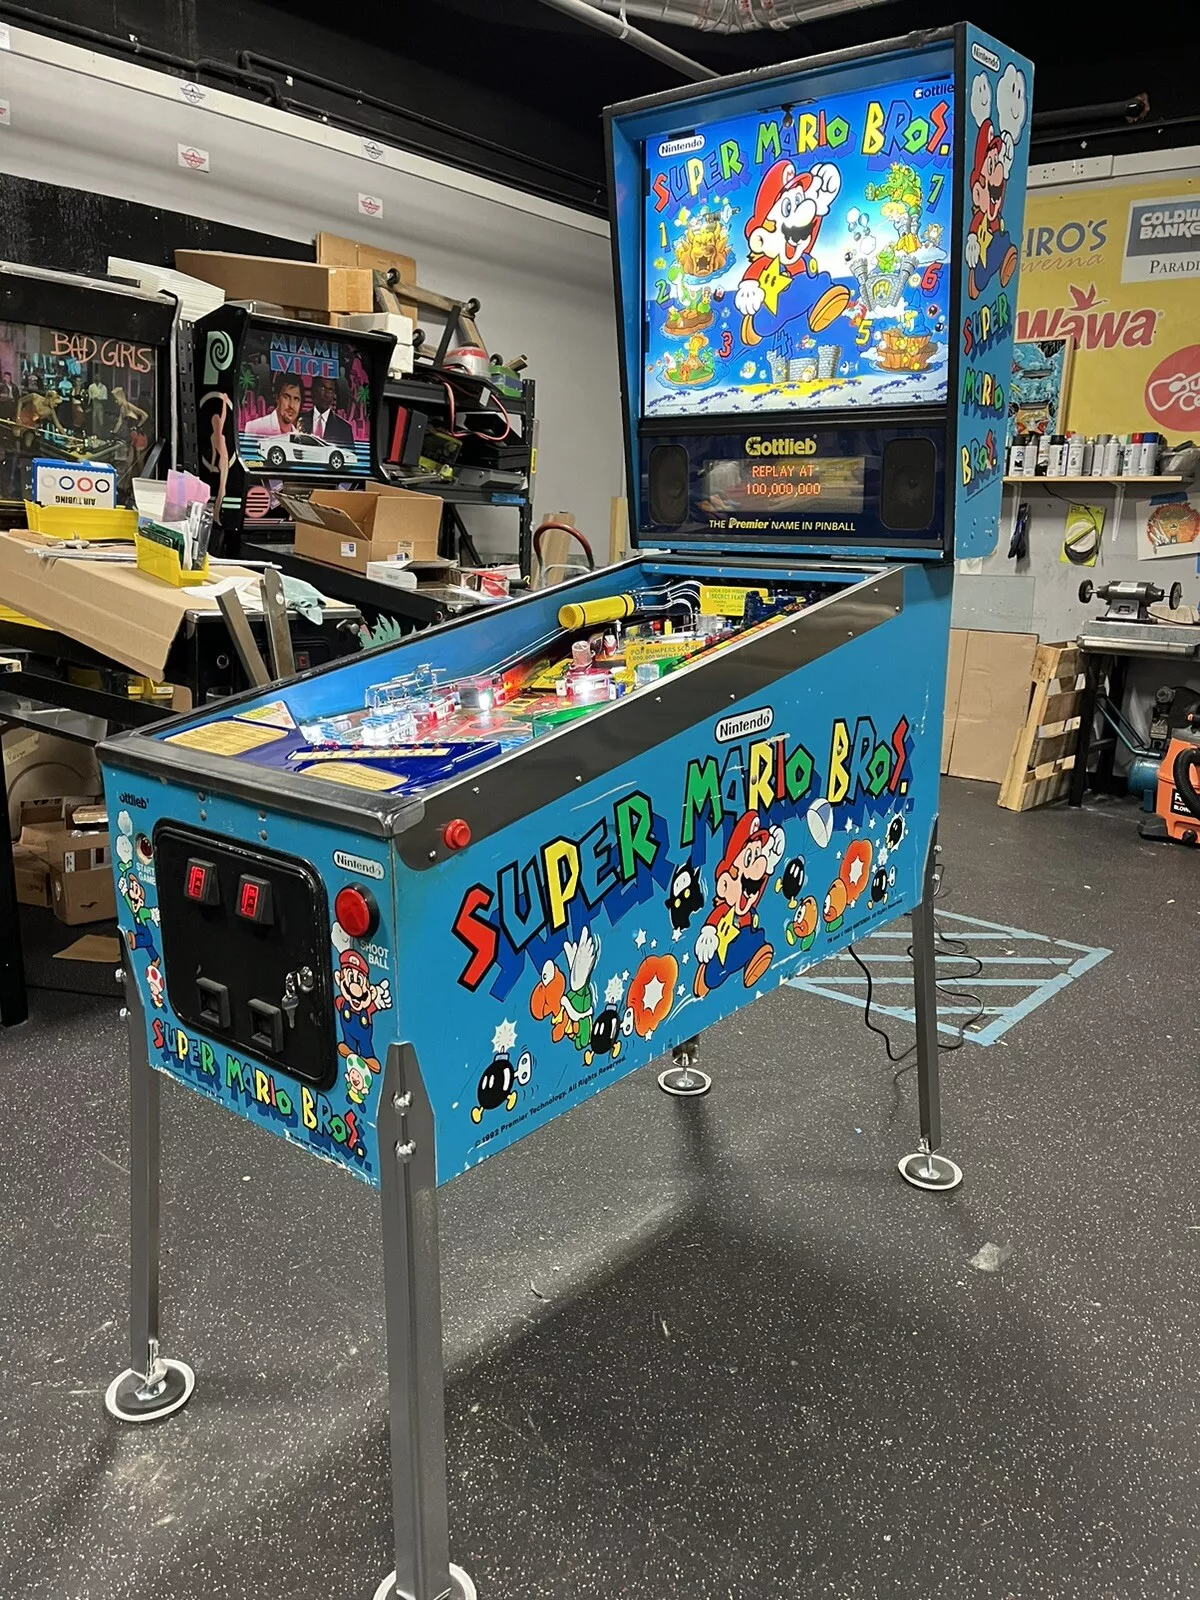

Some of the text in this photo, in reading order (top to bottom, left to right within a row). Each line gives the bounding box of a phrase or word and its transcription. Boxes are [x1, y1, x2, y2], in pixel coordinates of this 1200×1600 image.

[973, 44, 1000, 70] Nintendo
[661, 138, 703, 155] Nintendo
[652, 139, 744, 213] SUPER
[754, 109, 850, 165] MARIO
[962, 291, 1009, 357] SUPER
[50, 330, 153, 373] BAD GIRLS
[269, 332, 340, 359] MIAMI
[274, 353, 336, 379] VICE
[961, 366, 1004, 411] MARIO
[745, 435, 818, 457] Gottlieb
[752, 465, 815, 478] REPLAY AT
[54, 495, 96, 506] AIR TUBING
[746, 482, 821, 498] 100,000,000
[709, 517, 856, 532] THE Premier NAME IN PINBALL
[646, 646, 676, 655] BUMPERS
[718, 711, 771, 738] Nintendo
[118, 793, 148, 810] ottlieb
[136, 862, 155, 877] START
[336, 853, 382, 877] Nintendo
[450, 789, 660, 993] SUPER
[679, 737, 816, 850] MARIO
[138, 871, 157, 886] GAME
[360, 940, 389, 958] SHOOT
[368, 954, 390, 971] BALL
[151, 1017, 216, 1076] SUPER
[225, 1052, 293, 1117] MARIO
[500, 1111, 529, 1133] Premier
[568, 1083, 578, 1093] All
[577, 1071, 598, 1089] Rights
